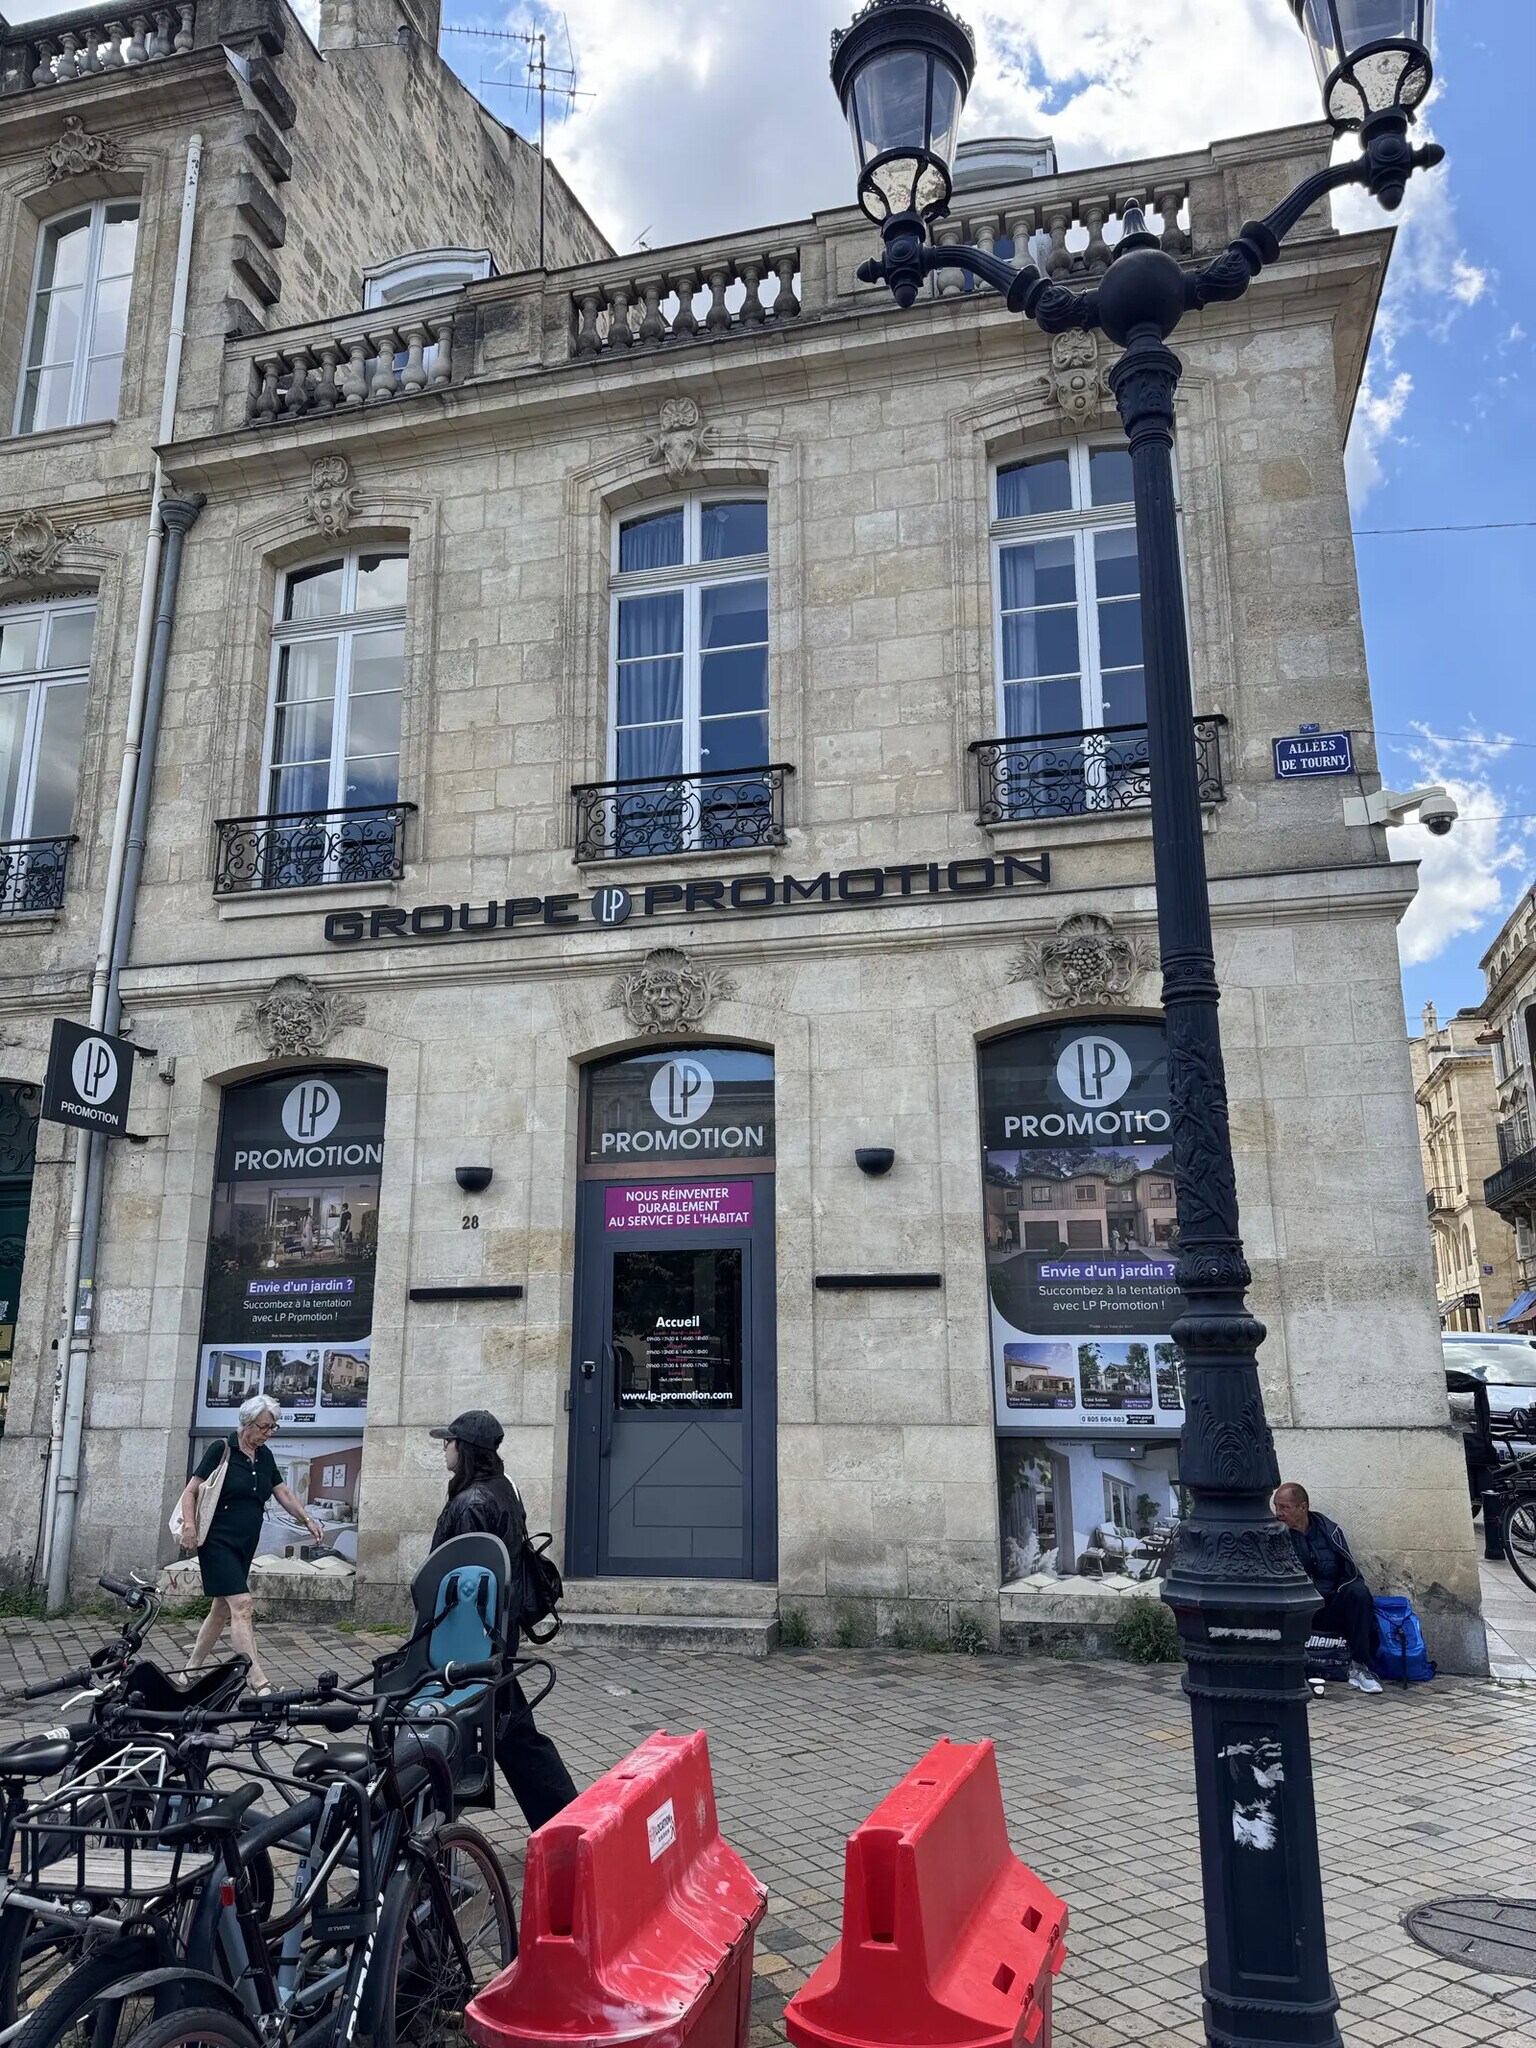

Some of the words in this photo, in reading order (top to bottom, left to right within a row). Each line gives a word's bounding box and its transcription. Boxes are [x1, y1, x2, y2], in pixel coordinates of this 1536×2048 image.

[1289, 740, 1336, 754] ALLÉES
[1282, 760, 1297, 771] DE
[1300, 755, 1347, 769] TOURNY
[324, 893, 580, 942] GROUPE
[602, 889, 624, 922] LP
[644, 853, 1051, 915] PROMOTION
[84, 1042, 110, 1098] LP
[1077, 1043, 1116, 1100] LP
[668, 1065, 702, 1119] LP
[61, 1101, 119, 1125] PROMOTION
[298, 1086, 330, 1137] LP
[1004, 1108, 1171, 1139] PROMOTIO
[601, 1126, 764, 1153] PROMOTION
[234, 1143, 382, 1171] PROMOTION
[626, 1190, 659, 1202] NOUS
[661, 1187, 729, 1200] RÉINVENTER
[638, 1200, 719, 1214] DURABLEMENT
[462, 1215, 479, 1230] 28
[608, 1217, 625, 1227] AU
[627, 1214, 673, 1226] SERVICE
[676, 1214, 691, 1225] DE
[693, 1212, 750, 1224] L'HABITAT
[1041, 1265, 1080, 1277] Envie
[1084, 1265, 1117, 1277] d'un
[1120, 1264, 1163, 1279] jardin
[1167, 1264, 1175, 1276] ?
[249, 1281, 280, 1293] Envie
[283, 1281, 308, 1292] d'un
[310, 1279, 343, 1293] jardin
[346, 1279, 353, 1290] ?
[1039, 1285, 1103, 1296] Succombez
[1106, 1285, 1114, 1295] à
[1117, 1285, 1127, 1295] la
[1130, 1284, 1181, 1295] tentation
[243, 1300, 293, 1310] Succombez
[295, 1299, 301, 1309] à
[302, 1299, 311, 1308] la
[313, 1298, 352, 1308] tentation
[1053, 1302, 1079, 1311] avec
[1082, 1301, 1097, 1310] LP
[1100, 1300, 1158, 1310] Promotion
[1161, 1300, 1165, 1310] !
[252, 1313, 273, 1323] avec
[274, 1313, 286, 1322] LP
[288, 1312, 333, 1323] Promotion
[334, 1311, 339, 1321] !
[655, 1315, 700, 1328] Accueil
[622, 1390, 733, 1402] www.lp-promotion.com
